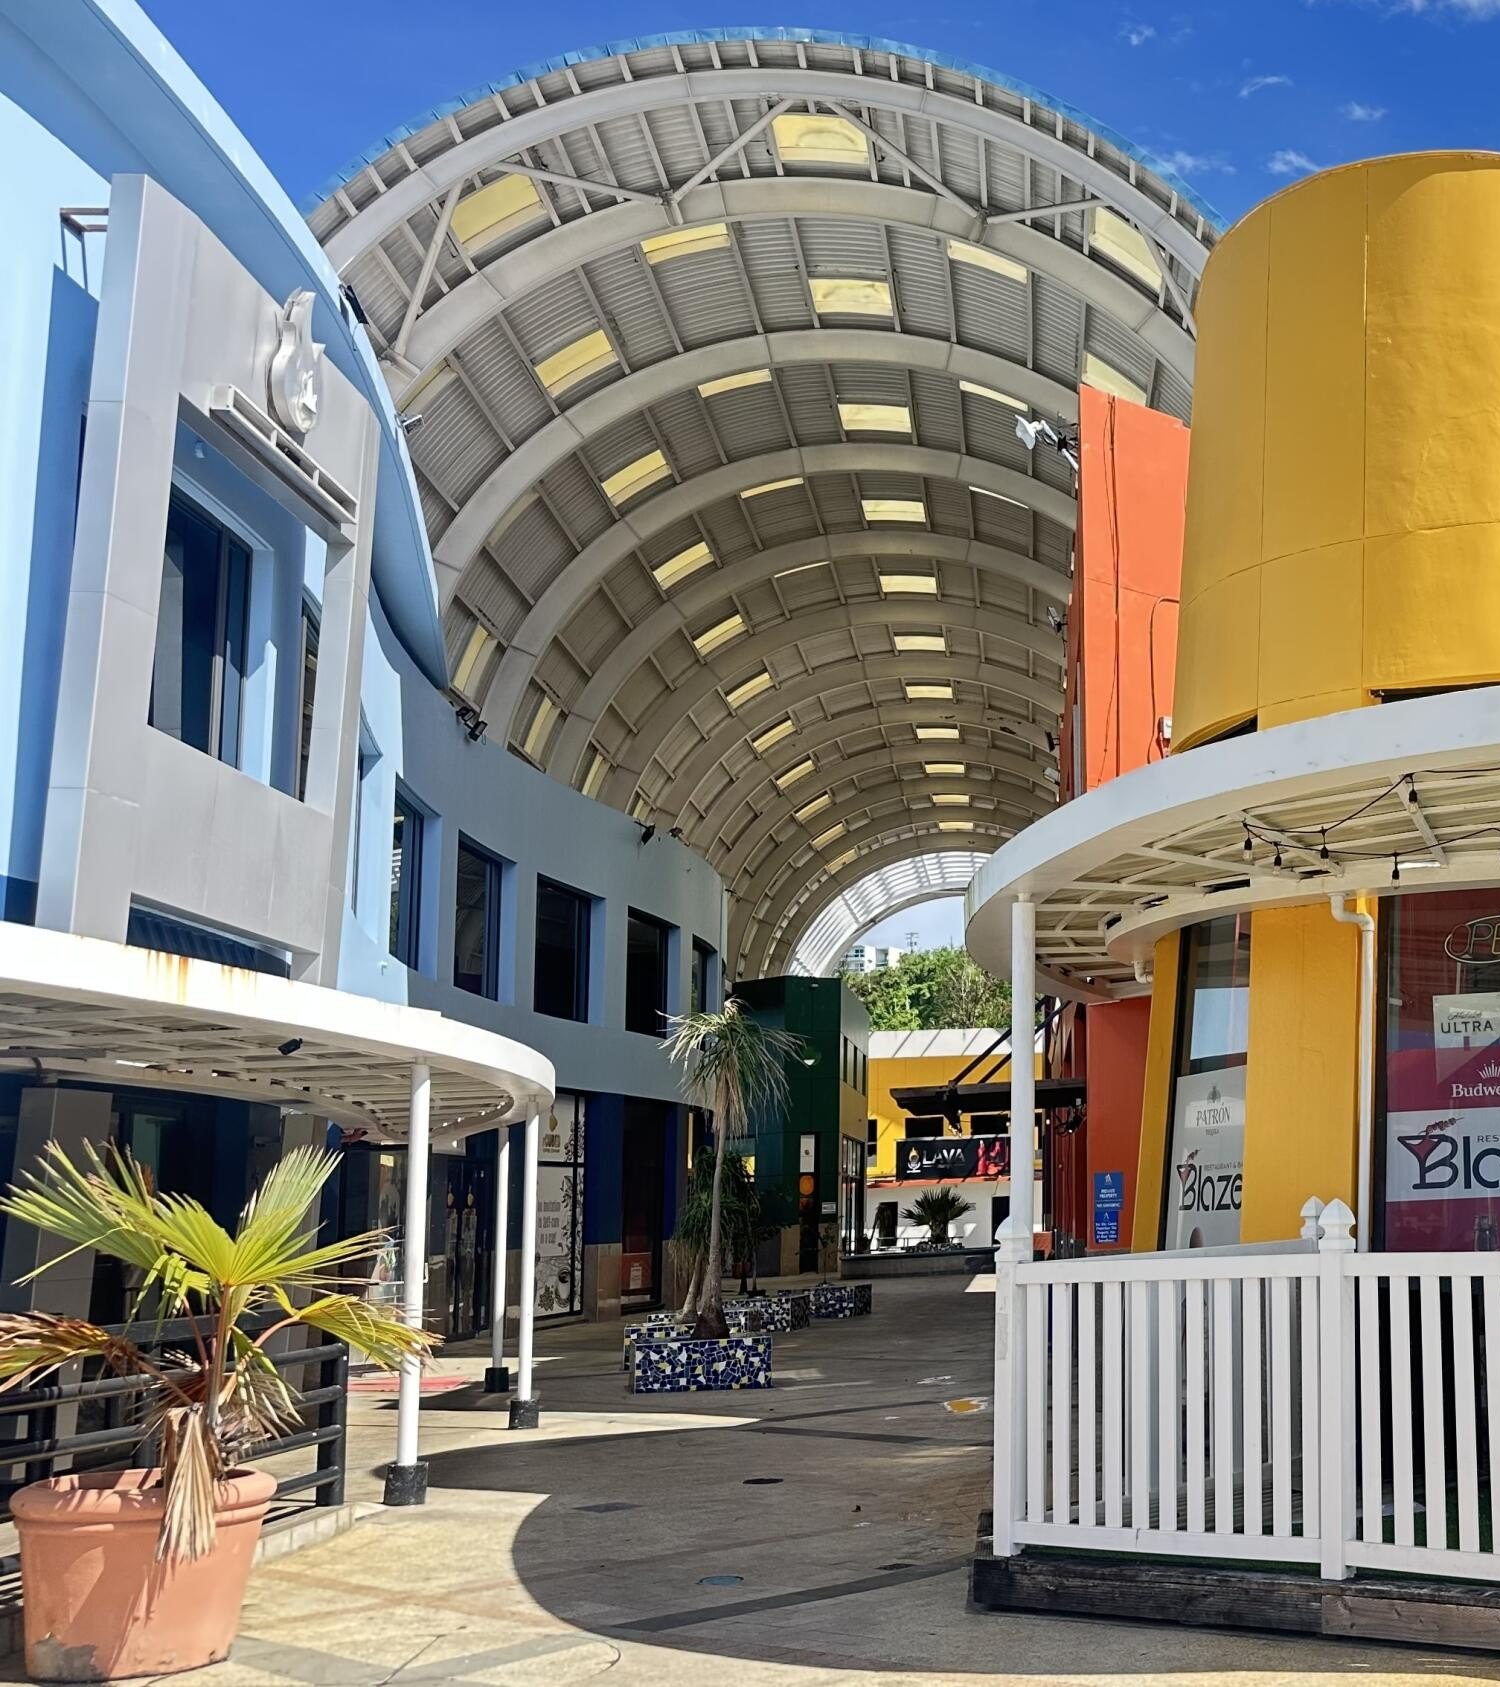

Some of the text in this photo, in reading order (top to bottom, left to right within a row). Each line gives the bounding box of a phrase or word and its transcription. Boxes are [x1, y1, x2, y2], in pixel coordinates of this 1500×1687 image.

[1441, 1021, 1494, 1034] ULTRA
[1197, 1102, 1231, 1127] PATRÓN
[922, 1149, 966, 1164] LAVA
[1176, 1164, 1242, 1211] Blaze
